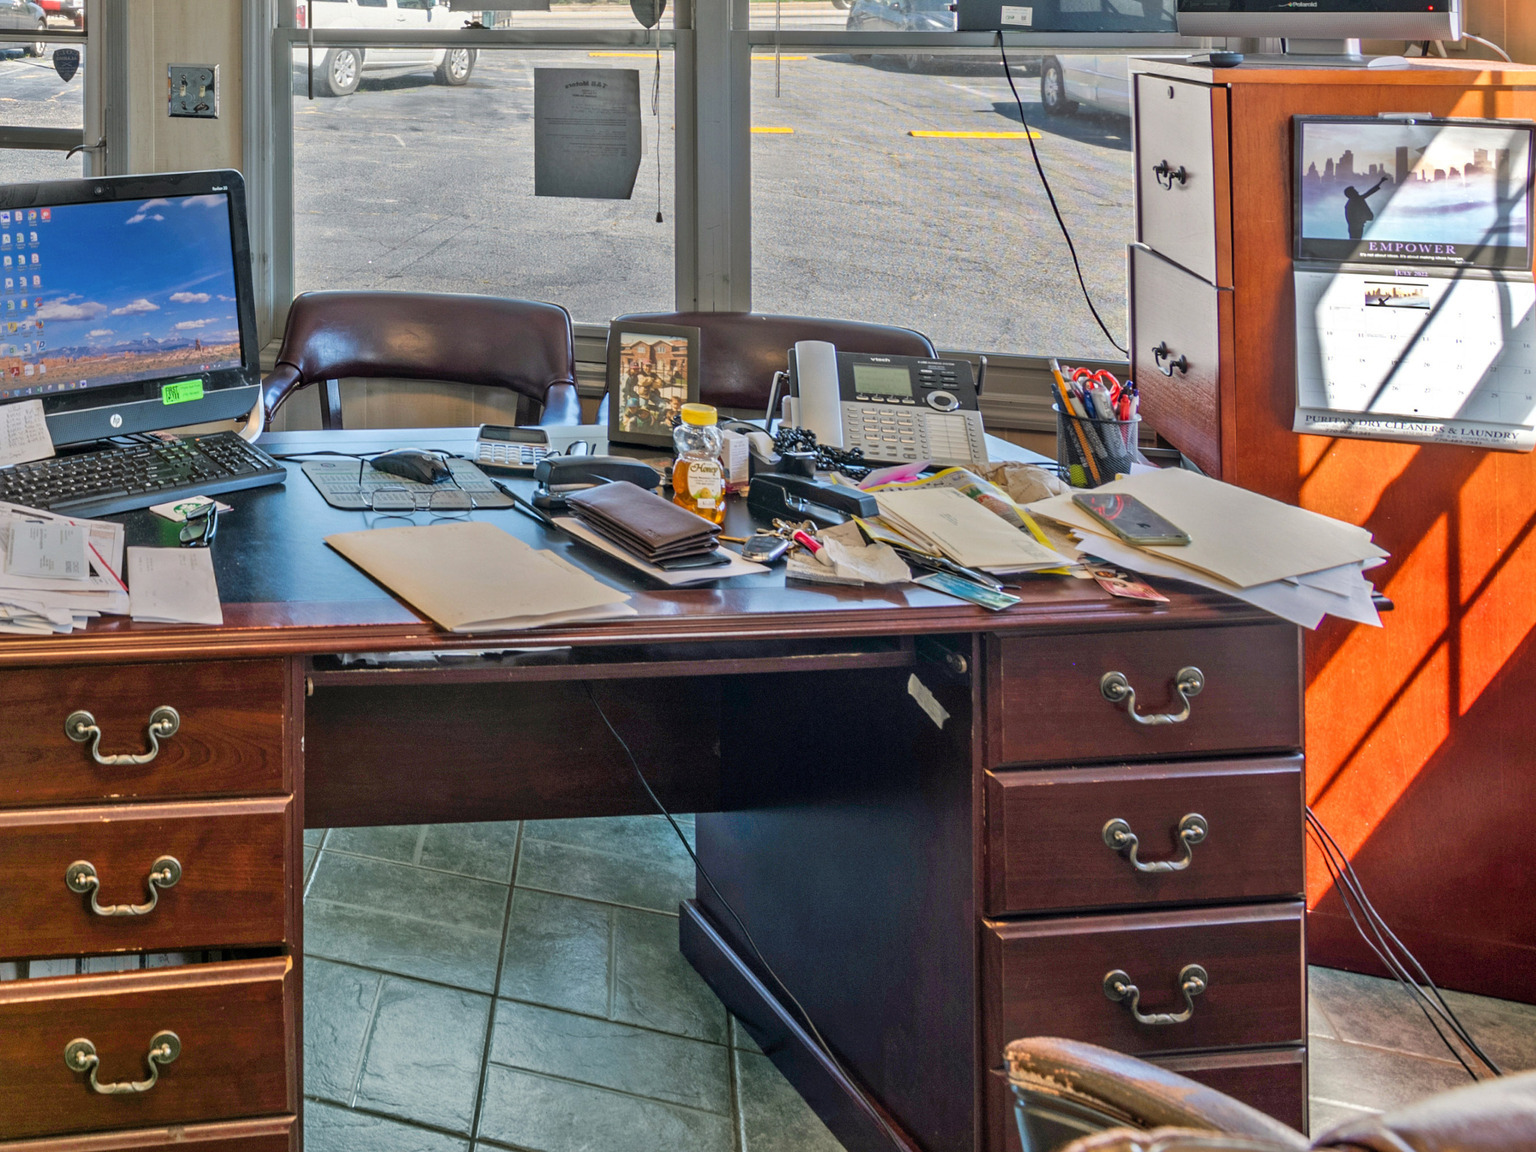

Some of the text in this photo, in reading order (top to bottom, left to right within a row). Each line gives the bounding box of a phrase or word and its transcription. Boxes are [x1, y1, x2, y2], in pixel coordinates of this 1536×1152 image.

[1368, 241, 1457, 255] EMPOWER
[1305, 414, 1356, 426] PURITAN
[1357, 417, 1381, 428] DRY
[1384, 420, 1445, 434] CLEANERS
[1447, 426, 1457, 435] &
[1460, 427, 1520, 440] LAUNDRY
[689, 462, 719, 476] Honey
